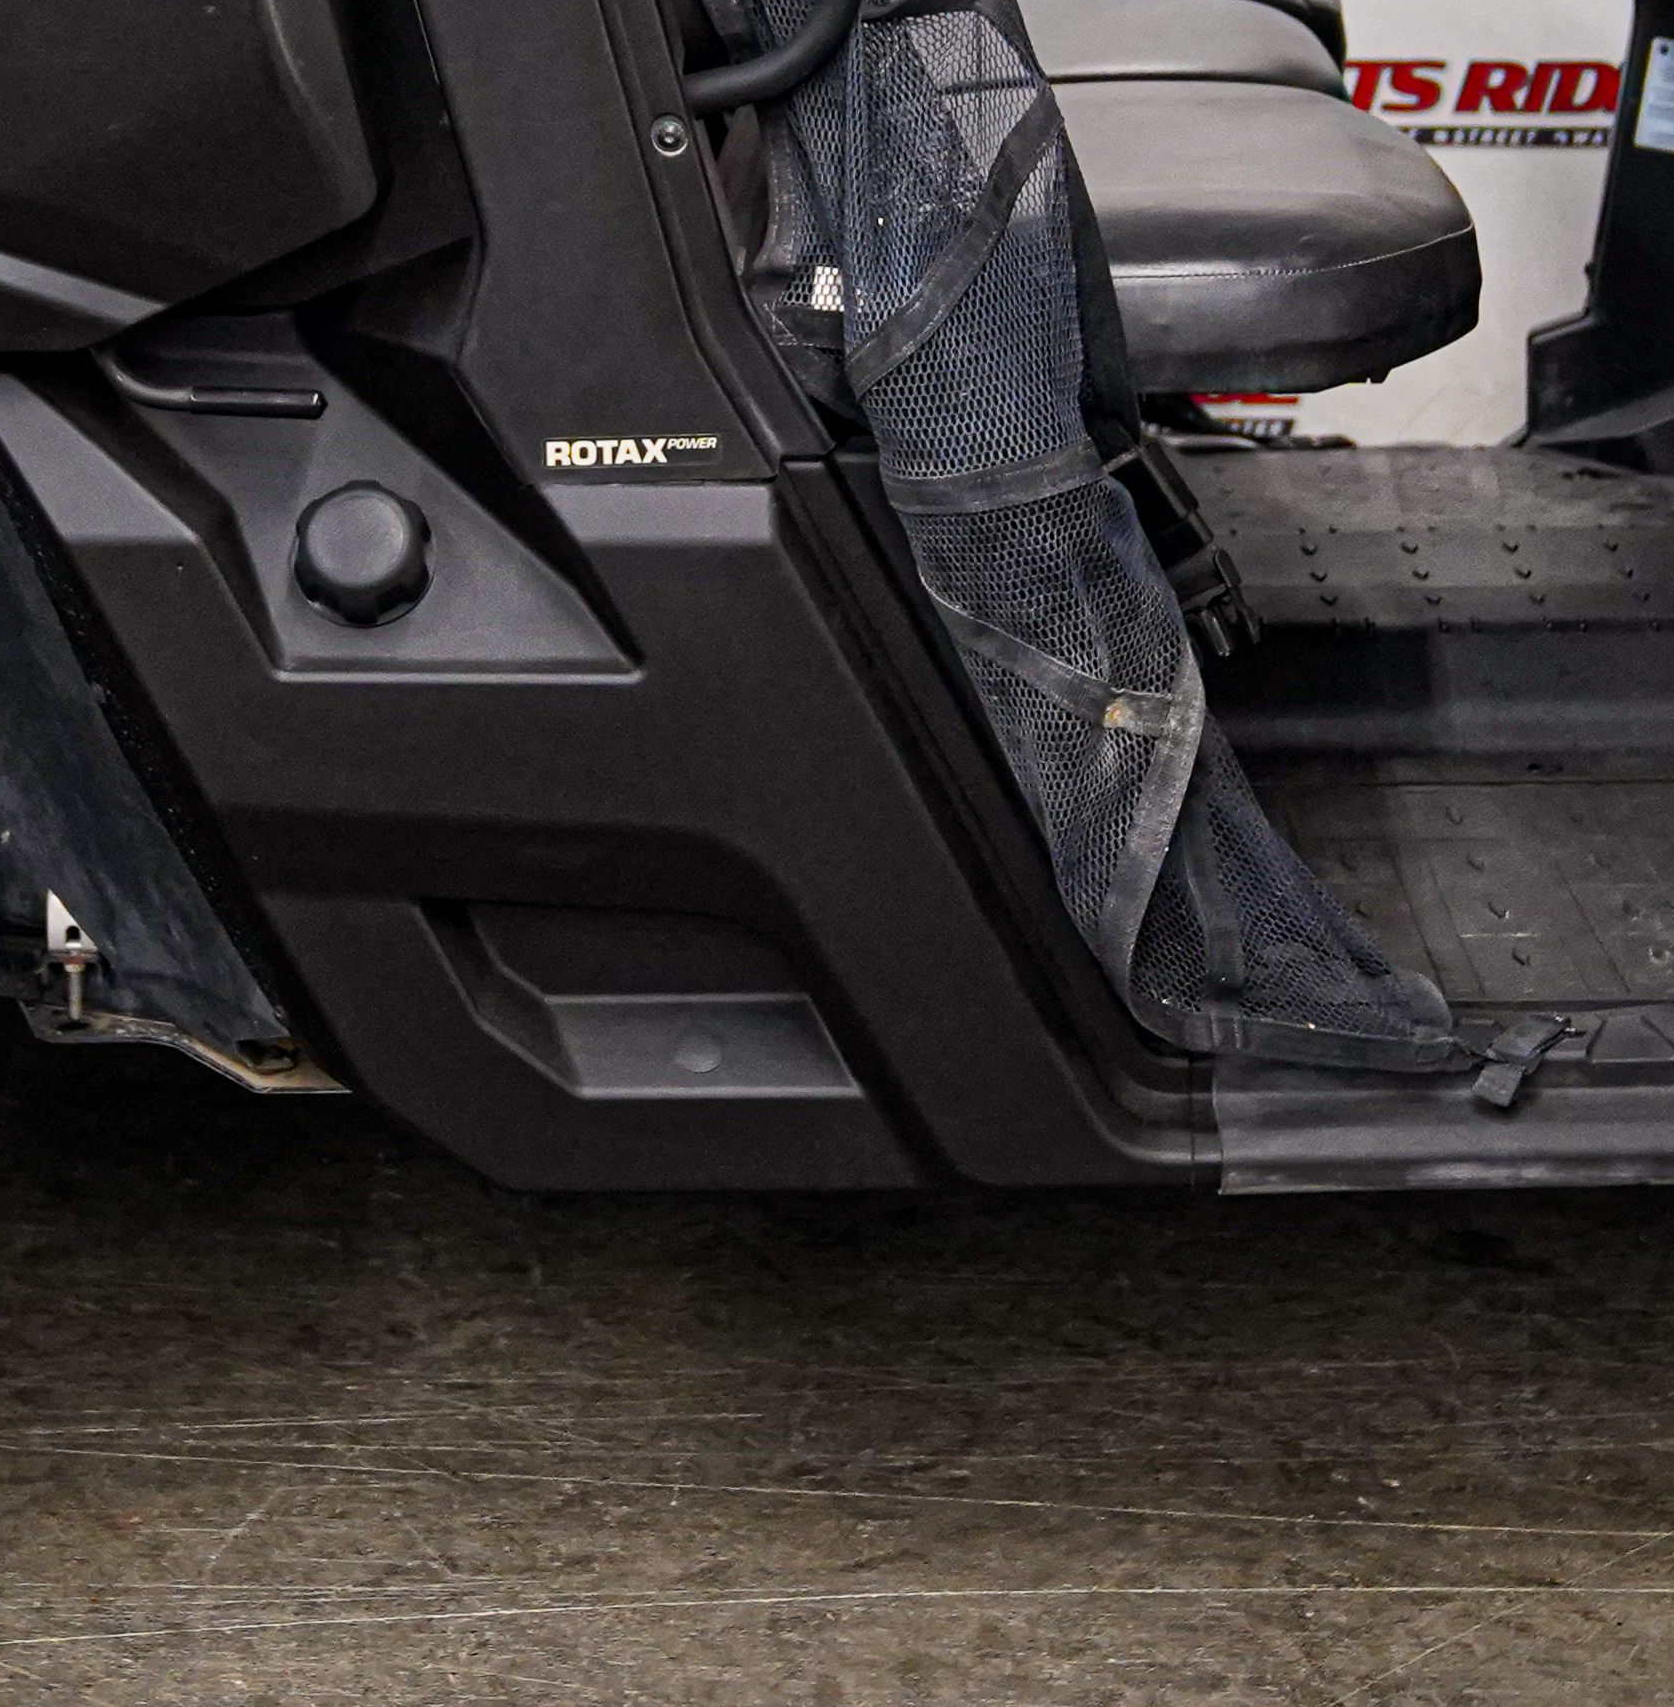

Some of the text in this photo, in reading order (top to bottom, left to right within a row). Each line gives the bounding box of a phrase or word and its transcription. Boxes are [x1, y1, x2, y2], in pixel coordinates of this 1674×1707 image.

[1344, 58, 1447, 113] TS
[1454, 59, 1622, 113] RID
[545, 435, 719, 468] ROTAX POWER
